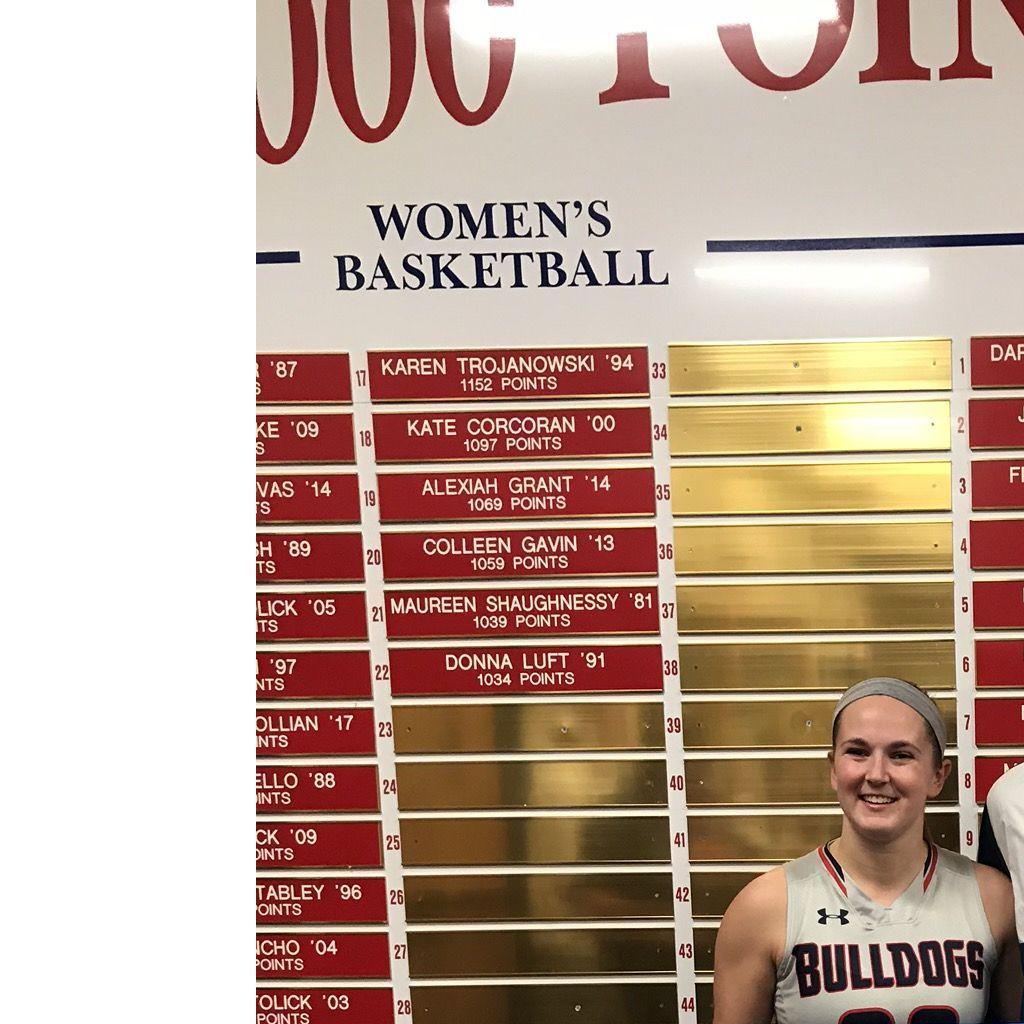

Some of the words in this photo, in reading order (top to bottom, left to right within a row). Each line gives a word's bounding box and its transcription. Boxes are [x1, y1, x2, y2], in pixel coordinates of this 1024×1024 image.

[366, 199, 612, 241] WOMEN'S
[333, 249, 669, 291] BASKETBALL
[270, 360, 298, 379] '87
[381, 357, 447, 376] KAREN
[456, 354, 595, 375] TROJANOWSKI
[605, 353, 634, 372] '94
[651, 362, 667, 380] 33
[960, 358, 967, 376] 1
[460, 377, 493, 392] 1152
[501, 375, 558, 391] POINTS
[290, 420, 320, 438] '09
[407, 418, 457, 437] KATE
[466, 415, 576, 436] CORCORAN
[586, 414, 616, 433] '00
[359, 430, 372, 448] 18
[463, 437, 498, 452] 1097
[505, 436, 562, 451] POINTS
[305, 480, 332, 498] '14
[421, 477, 498, 496] ALEXIAH
[508, 475, 574, 495] GRANT
[584, 474, 611, 492] '14
[467, 497, 503, 512] 1069
[510, 495, 567, 511] POINTS
[283, 540, 312, 558] '89
[422, 536, 512, 556] COLLEEN
[521, 535, 578, 554] GAVIN
[588, 534, 615, 552] '13
[470, 556, 505, 571] 1059
[512, 554, 569, 570] POINTS
[308, 598, 336, 616] '05
[390, 595, 477, 615] MAUREEN
[485, 593, 620, 613] SHAUGHNESSY
[629, 592, 652, 610] '81
[472, 615, 508, 629] 1039
[515, 613, 571, 628] POINTS
[270, 658, 297, 675] '97
[445, 653, 514, 671] DONNA
[522, 652, 570, 670] LUFT
[580, 651, 605, 669] '91
[477, 672, 512, 687] 1034
[519, 671, 575, 686] POINTS
[329, 714, 354, 731] '17
[378, 721, 393, 738] 23
[308, 772, 336, 789] '88
[669, 775, 684, 791] 40
[289, 828, 318, 845] '09
[965, 831, 974, 847] 9
[335, 884, 362, 901] '96
[310, 939, 338, 956] '04
[792, 939, 985, 998] BULLDOGS
[322, 994, 350, 1011] '03
[397, 998, 413, 1016] 28
